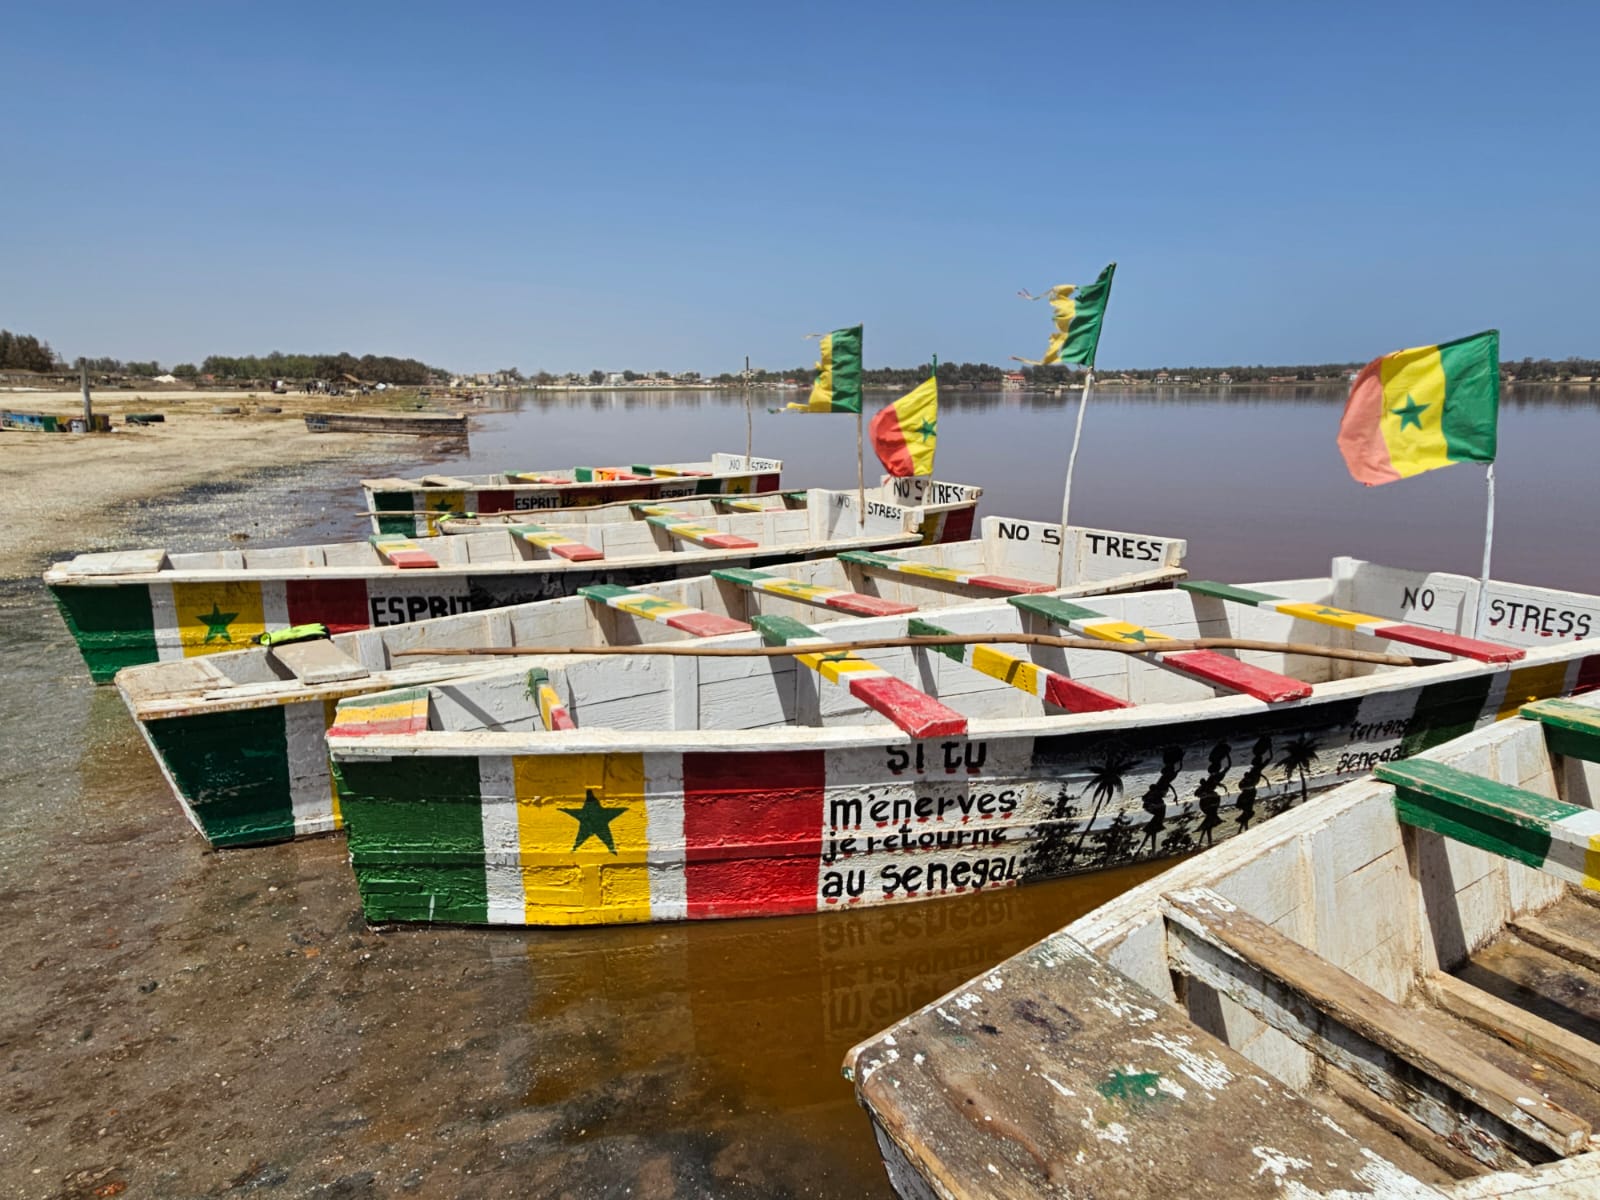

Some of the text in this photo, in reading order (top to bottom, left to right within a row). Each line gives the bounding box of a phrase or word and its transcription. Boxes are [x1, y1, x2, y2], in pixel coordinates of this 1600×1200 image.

[894, 477, 910, 498] NO
[515, 497, 560, 510] ESPRIT
[836, 496, 902, 519] NO STRESS
[999, 522, 1030, 541] NO
[371, 595, 470, 627] ESPRIT
[1401, 586, 1592, 638] NO STRESS
[823, 823, 1007, 862] je retourne
[822, 870, 865, 898] au
